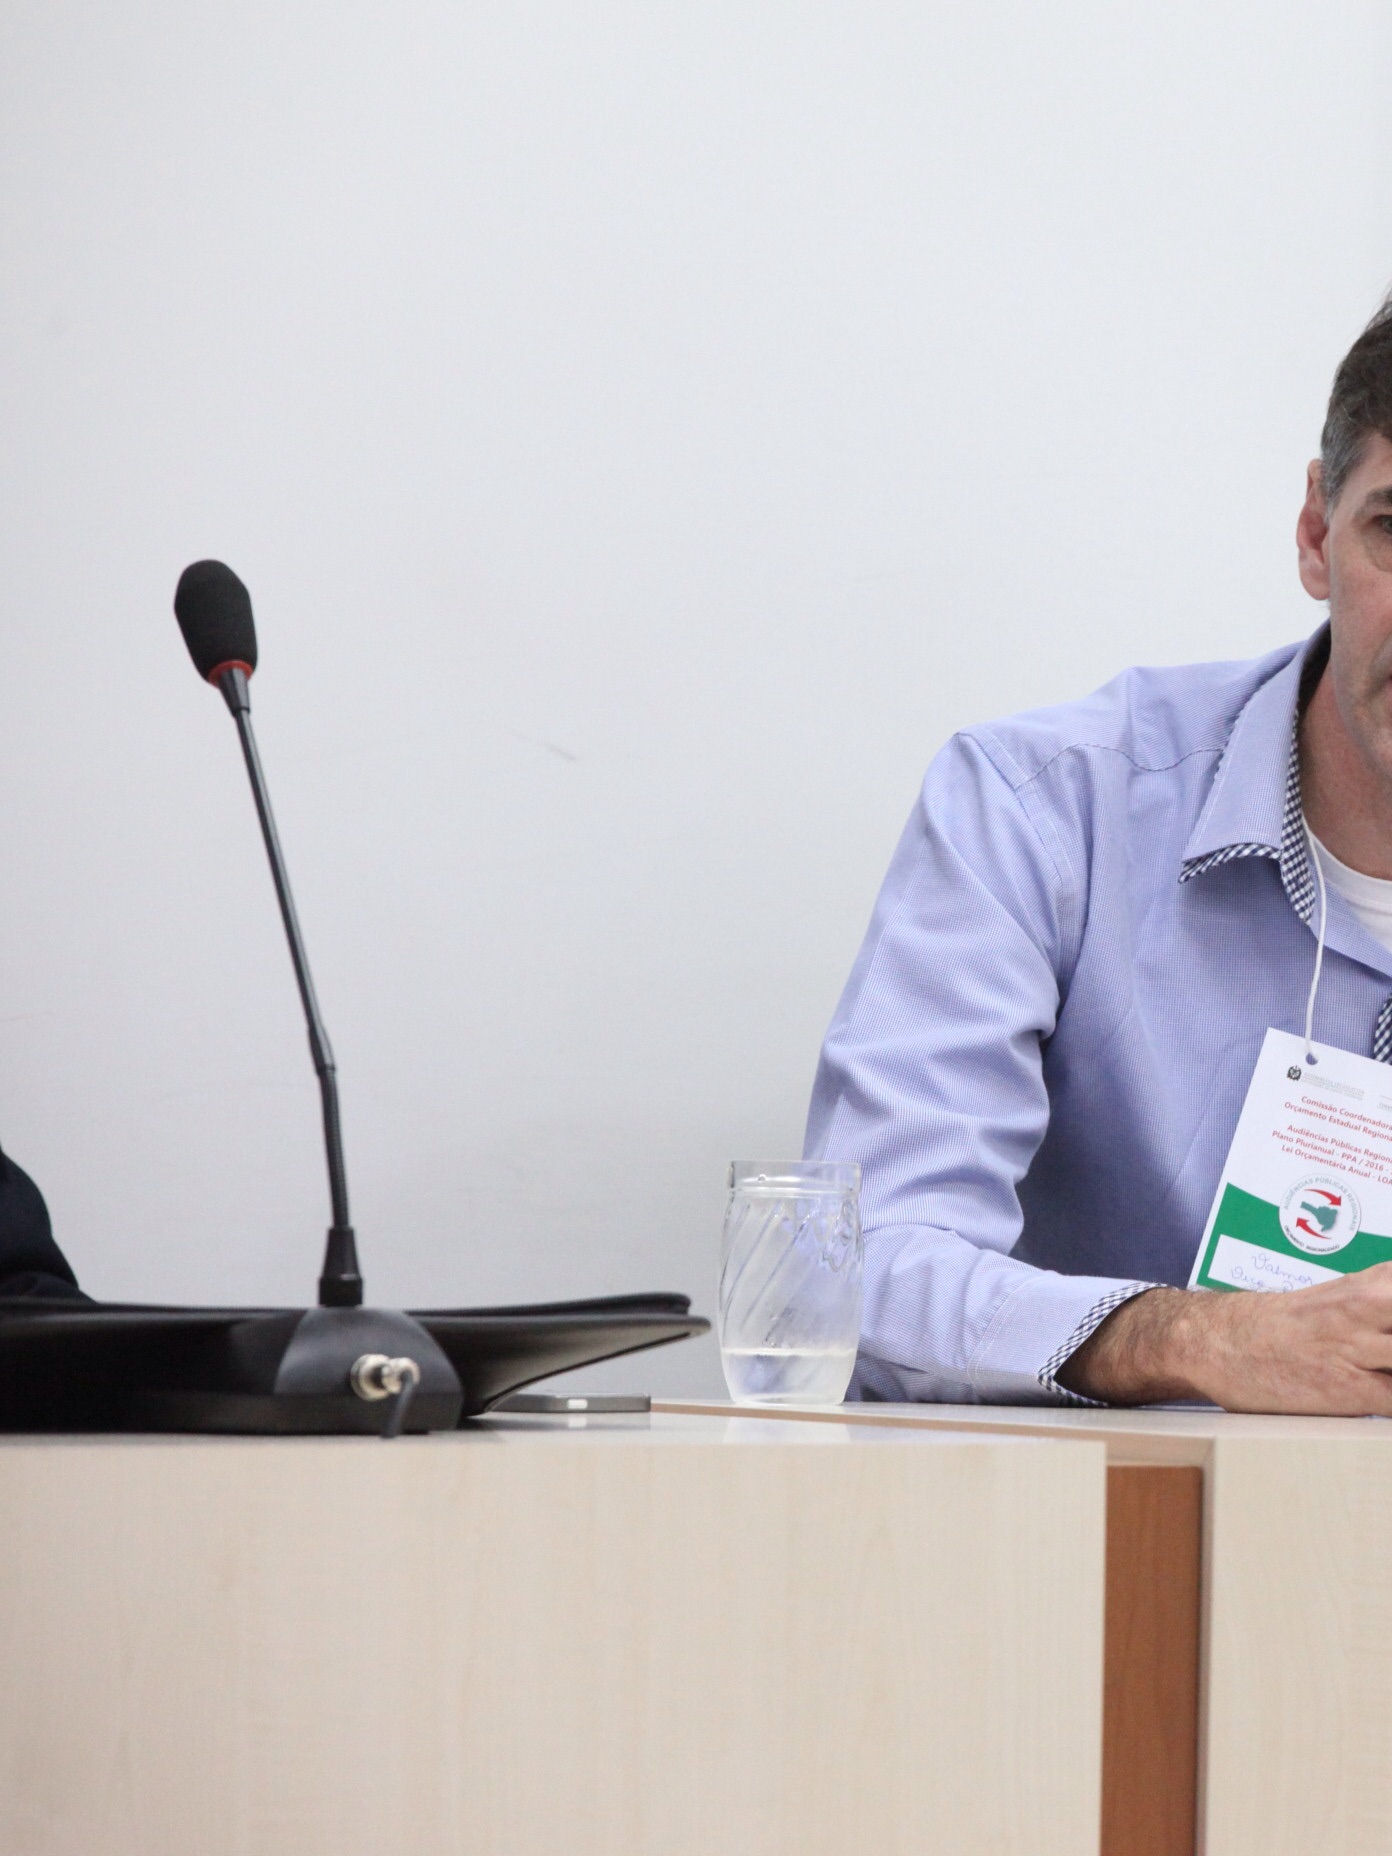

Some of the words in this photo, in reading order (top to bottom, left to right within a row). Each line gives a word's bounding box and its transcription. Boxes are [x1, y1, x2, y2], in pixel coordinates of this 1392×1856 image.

[1284, 1101, 1327, 1121] Orçamento
[1328, 1115, 1361, 1132] Estadual
[1301, 1095, 1337, 1113] Comissão
[1272, 1130, 1294, 1143] Plano
[1295, 1137, 1335, 1156] Plurianual
[1341, 1152, 1357, 1164] PPA
[1364, 1159, 1384, 1172] 2016
[1287, 1124, 1329, 1143] Audiências
[1331, 1137, 1362, 1154] Públicas
[1281, 1144, 1293, 1154] Lei
[1294, 1148, 1346, 1171] Orçamentária
[1347, 1165, 1371, 1179] Anual
